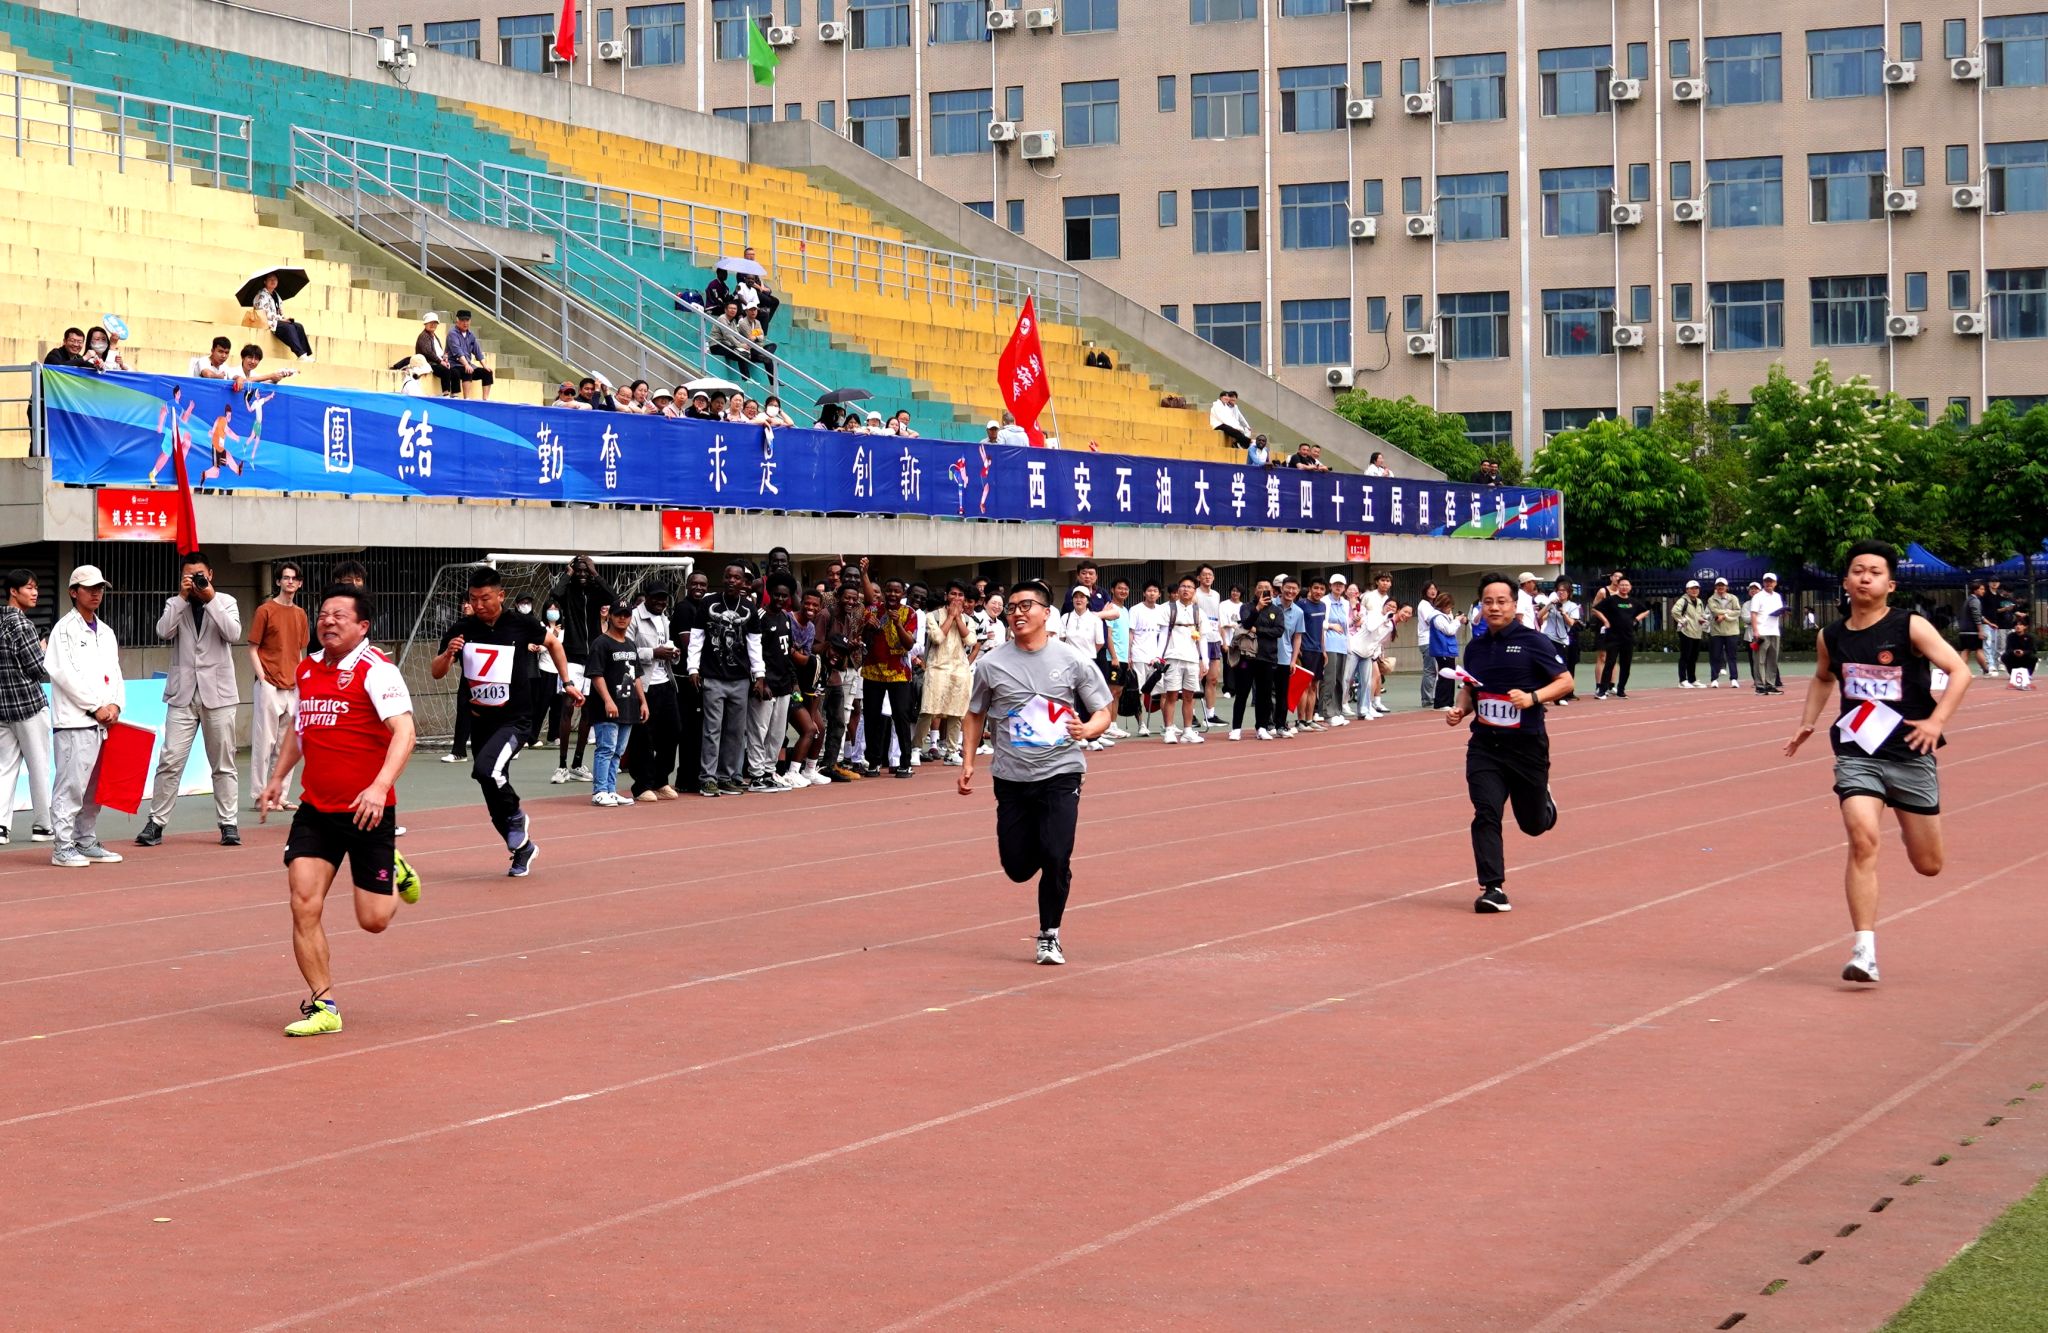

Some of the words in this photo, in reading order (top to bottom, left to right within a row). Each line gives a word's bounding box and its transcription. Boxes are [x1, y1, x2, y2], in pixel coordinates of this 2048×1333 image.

[323, 406, 433, 480] 團結
[536, 421, 622, 489] 勤奮
[852, 445, 921, 501] 創新
[1027, 461, 1528, 531] 西安石油大学第四十五届田径运动会
[112, 510, 168, 527] 机关三工会
[475, 648, 499, 677] 7
[1111, 671, 1117, 681] 2
[2015, 672, 2023, 684] 6
[301, 696, 349, 713] mirates
